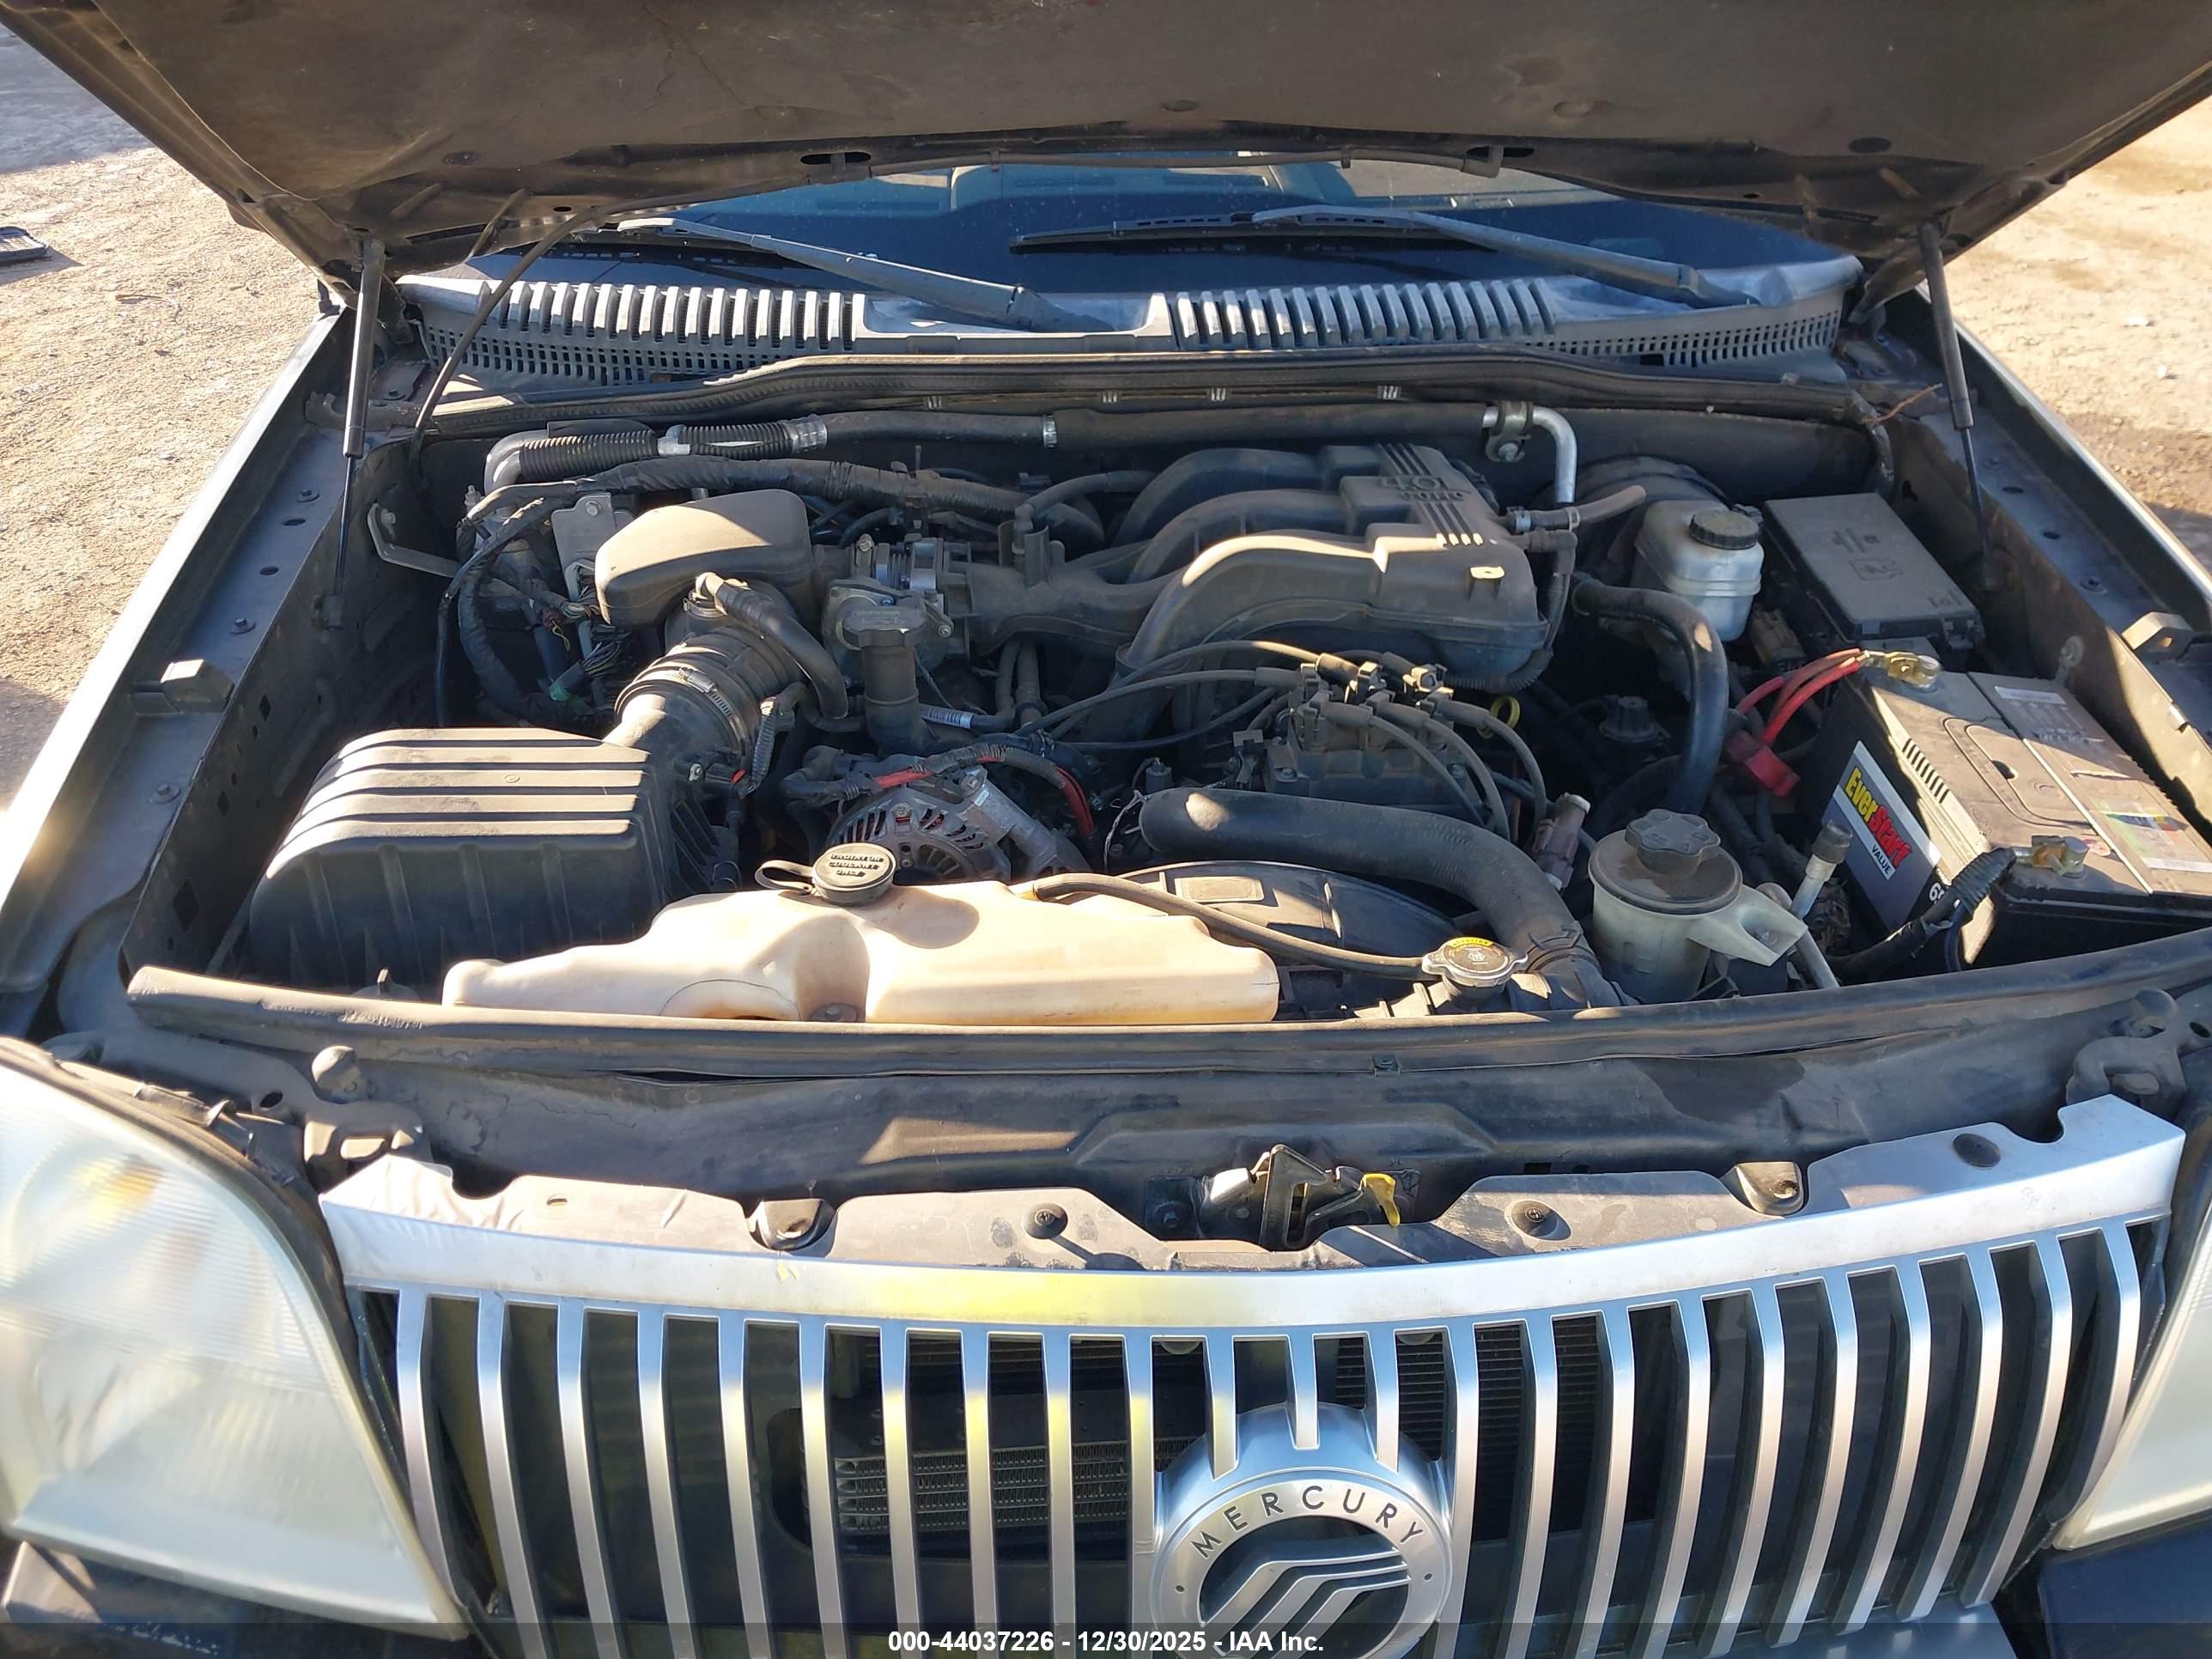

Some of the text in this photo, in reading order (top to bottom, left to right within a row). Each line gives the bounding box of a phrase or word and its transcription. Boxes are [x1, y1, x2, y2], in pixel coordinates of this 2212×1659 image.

[1845, 768, 1912, 866] EverStart
[836, 869, 866, 878] ONLY
[1871, 844, 1892, 876] VALUE
[1190, 1485, 1424, 1559] MERCURY
